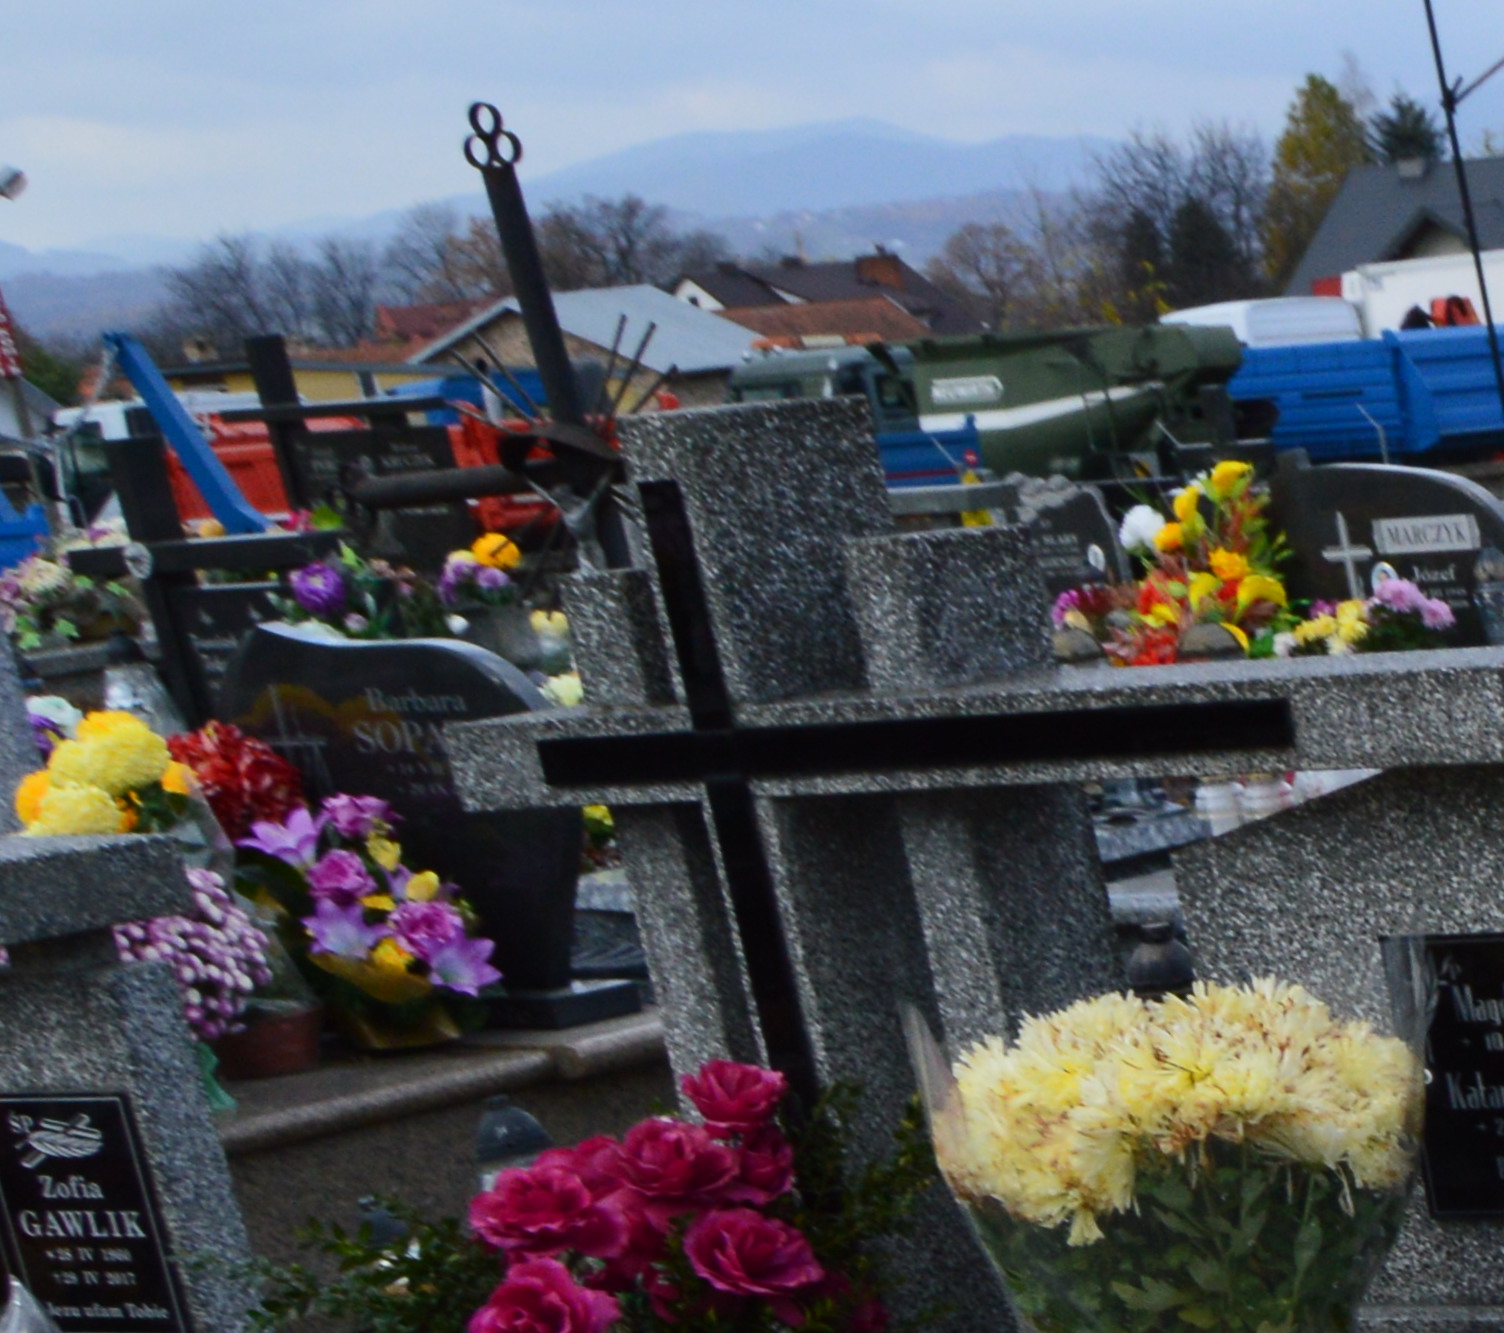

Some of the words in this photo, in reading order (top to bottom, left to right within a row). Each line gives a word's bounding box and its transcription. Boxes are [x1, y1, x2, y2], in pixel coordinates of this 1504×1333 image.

[1386, 521, 1467, 546] MARCZYK
[38, 1174, 105, 1200] Zofia
[18, 1208, 147, 1239] GAWLIK
